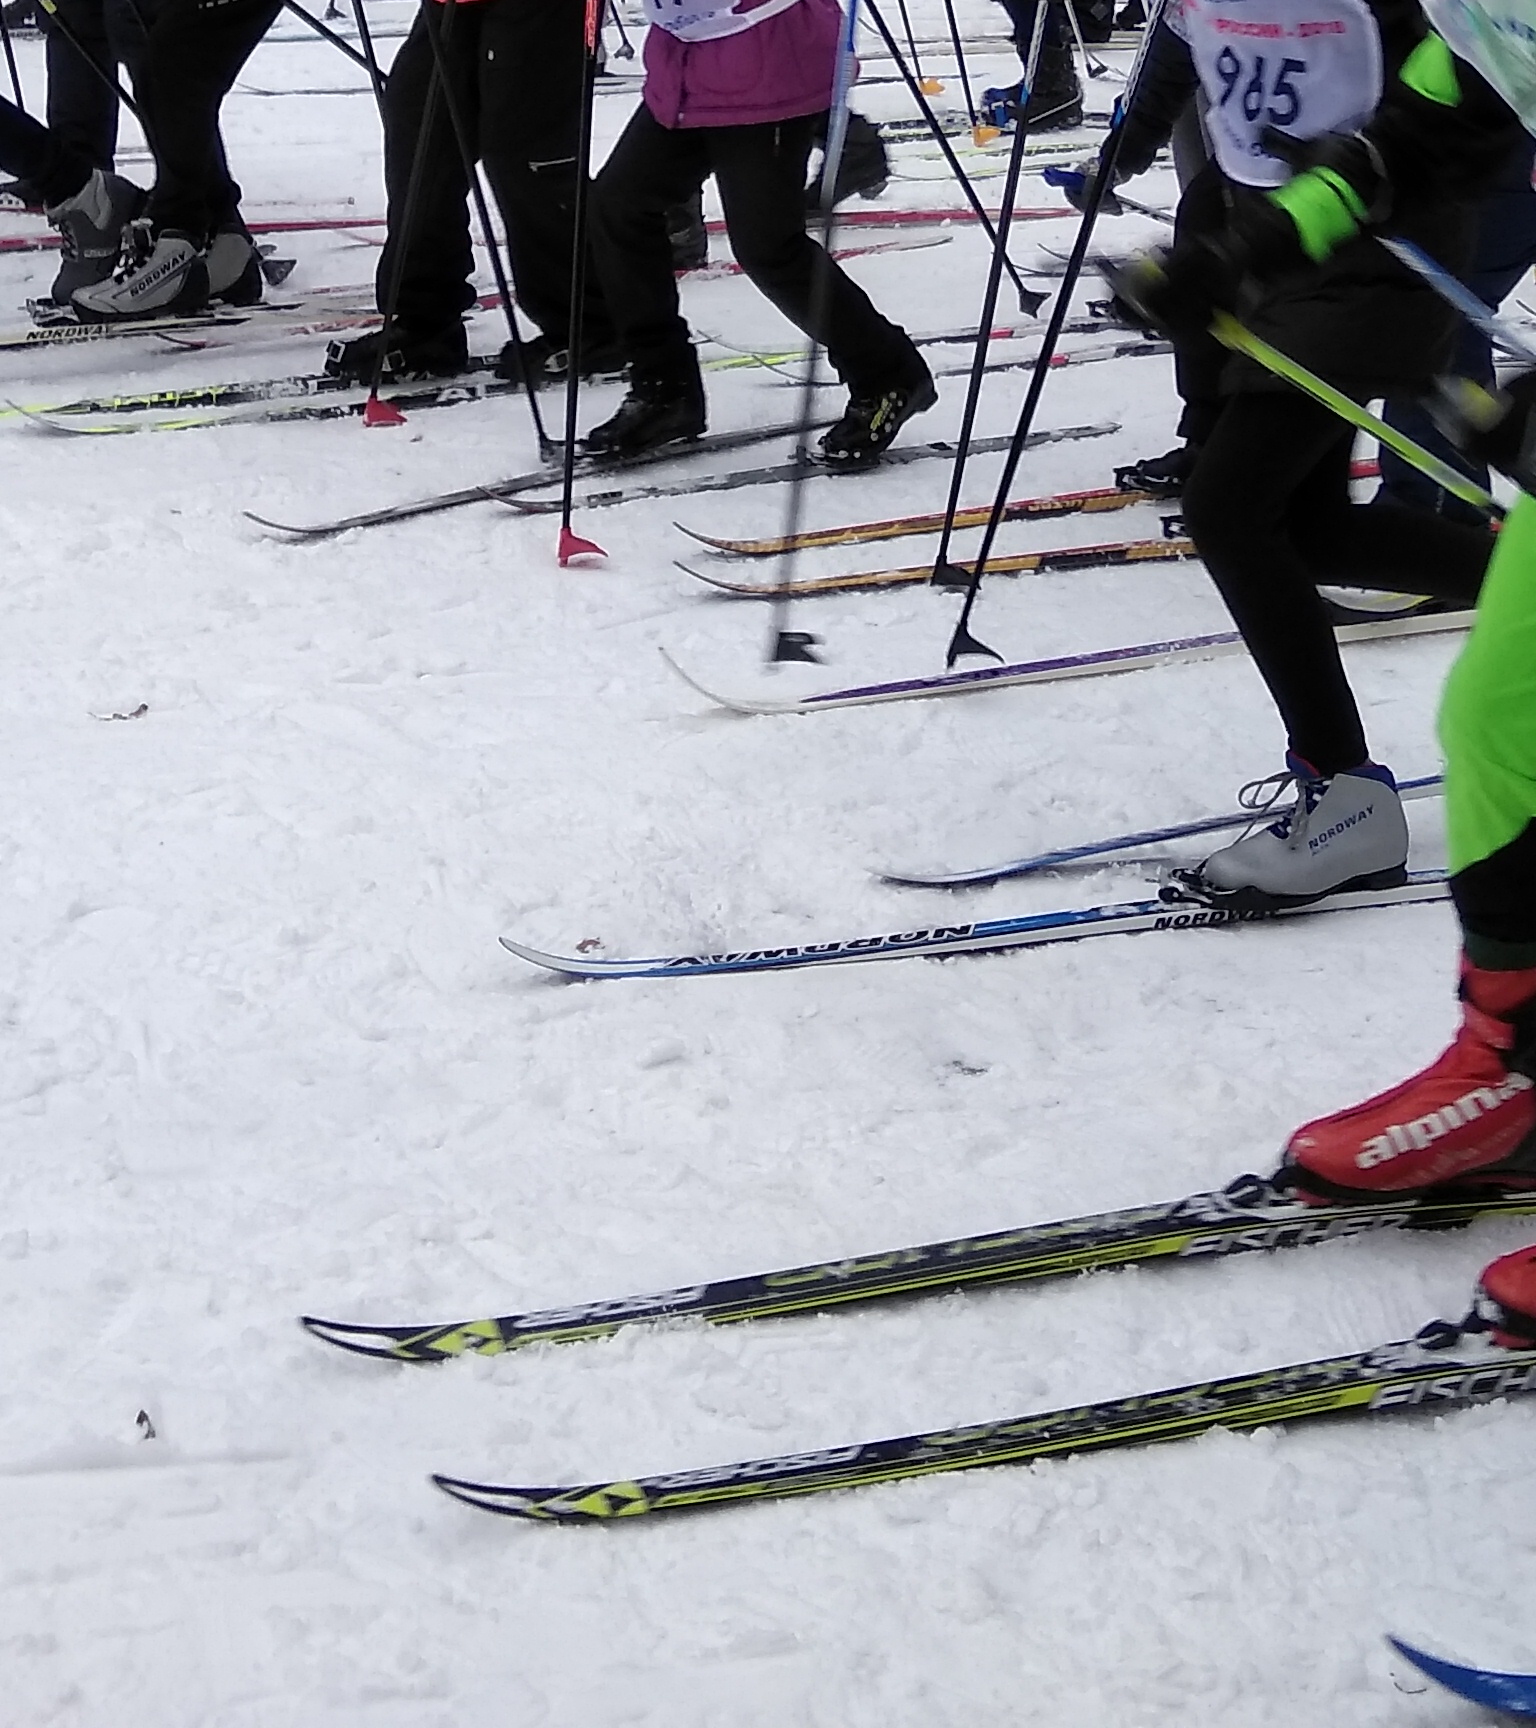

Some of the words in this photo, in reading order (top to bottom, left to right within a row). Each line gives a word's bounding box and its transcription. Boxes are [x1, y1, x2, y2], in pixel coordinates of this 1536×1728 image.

[130, 251, 187, 297] NORDWAY
[26, 324, 112, 341] NORDWAY
[1309, 803, 1375, 850] NORDWAY
[664, 924, 977, 968] NORDWAY
[1356, 1072, 1534, 1169] alpina
